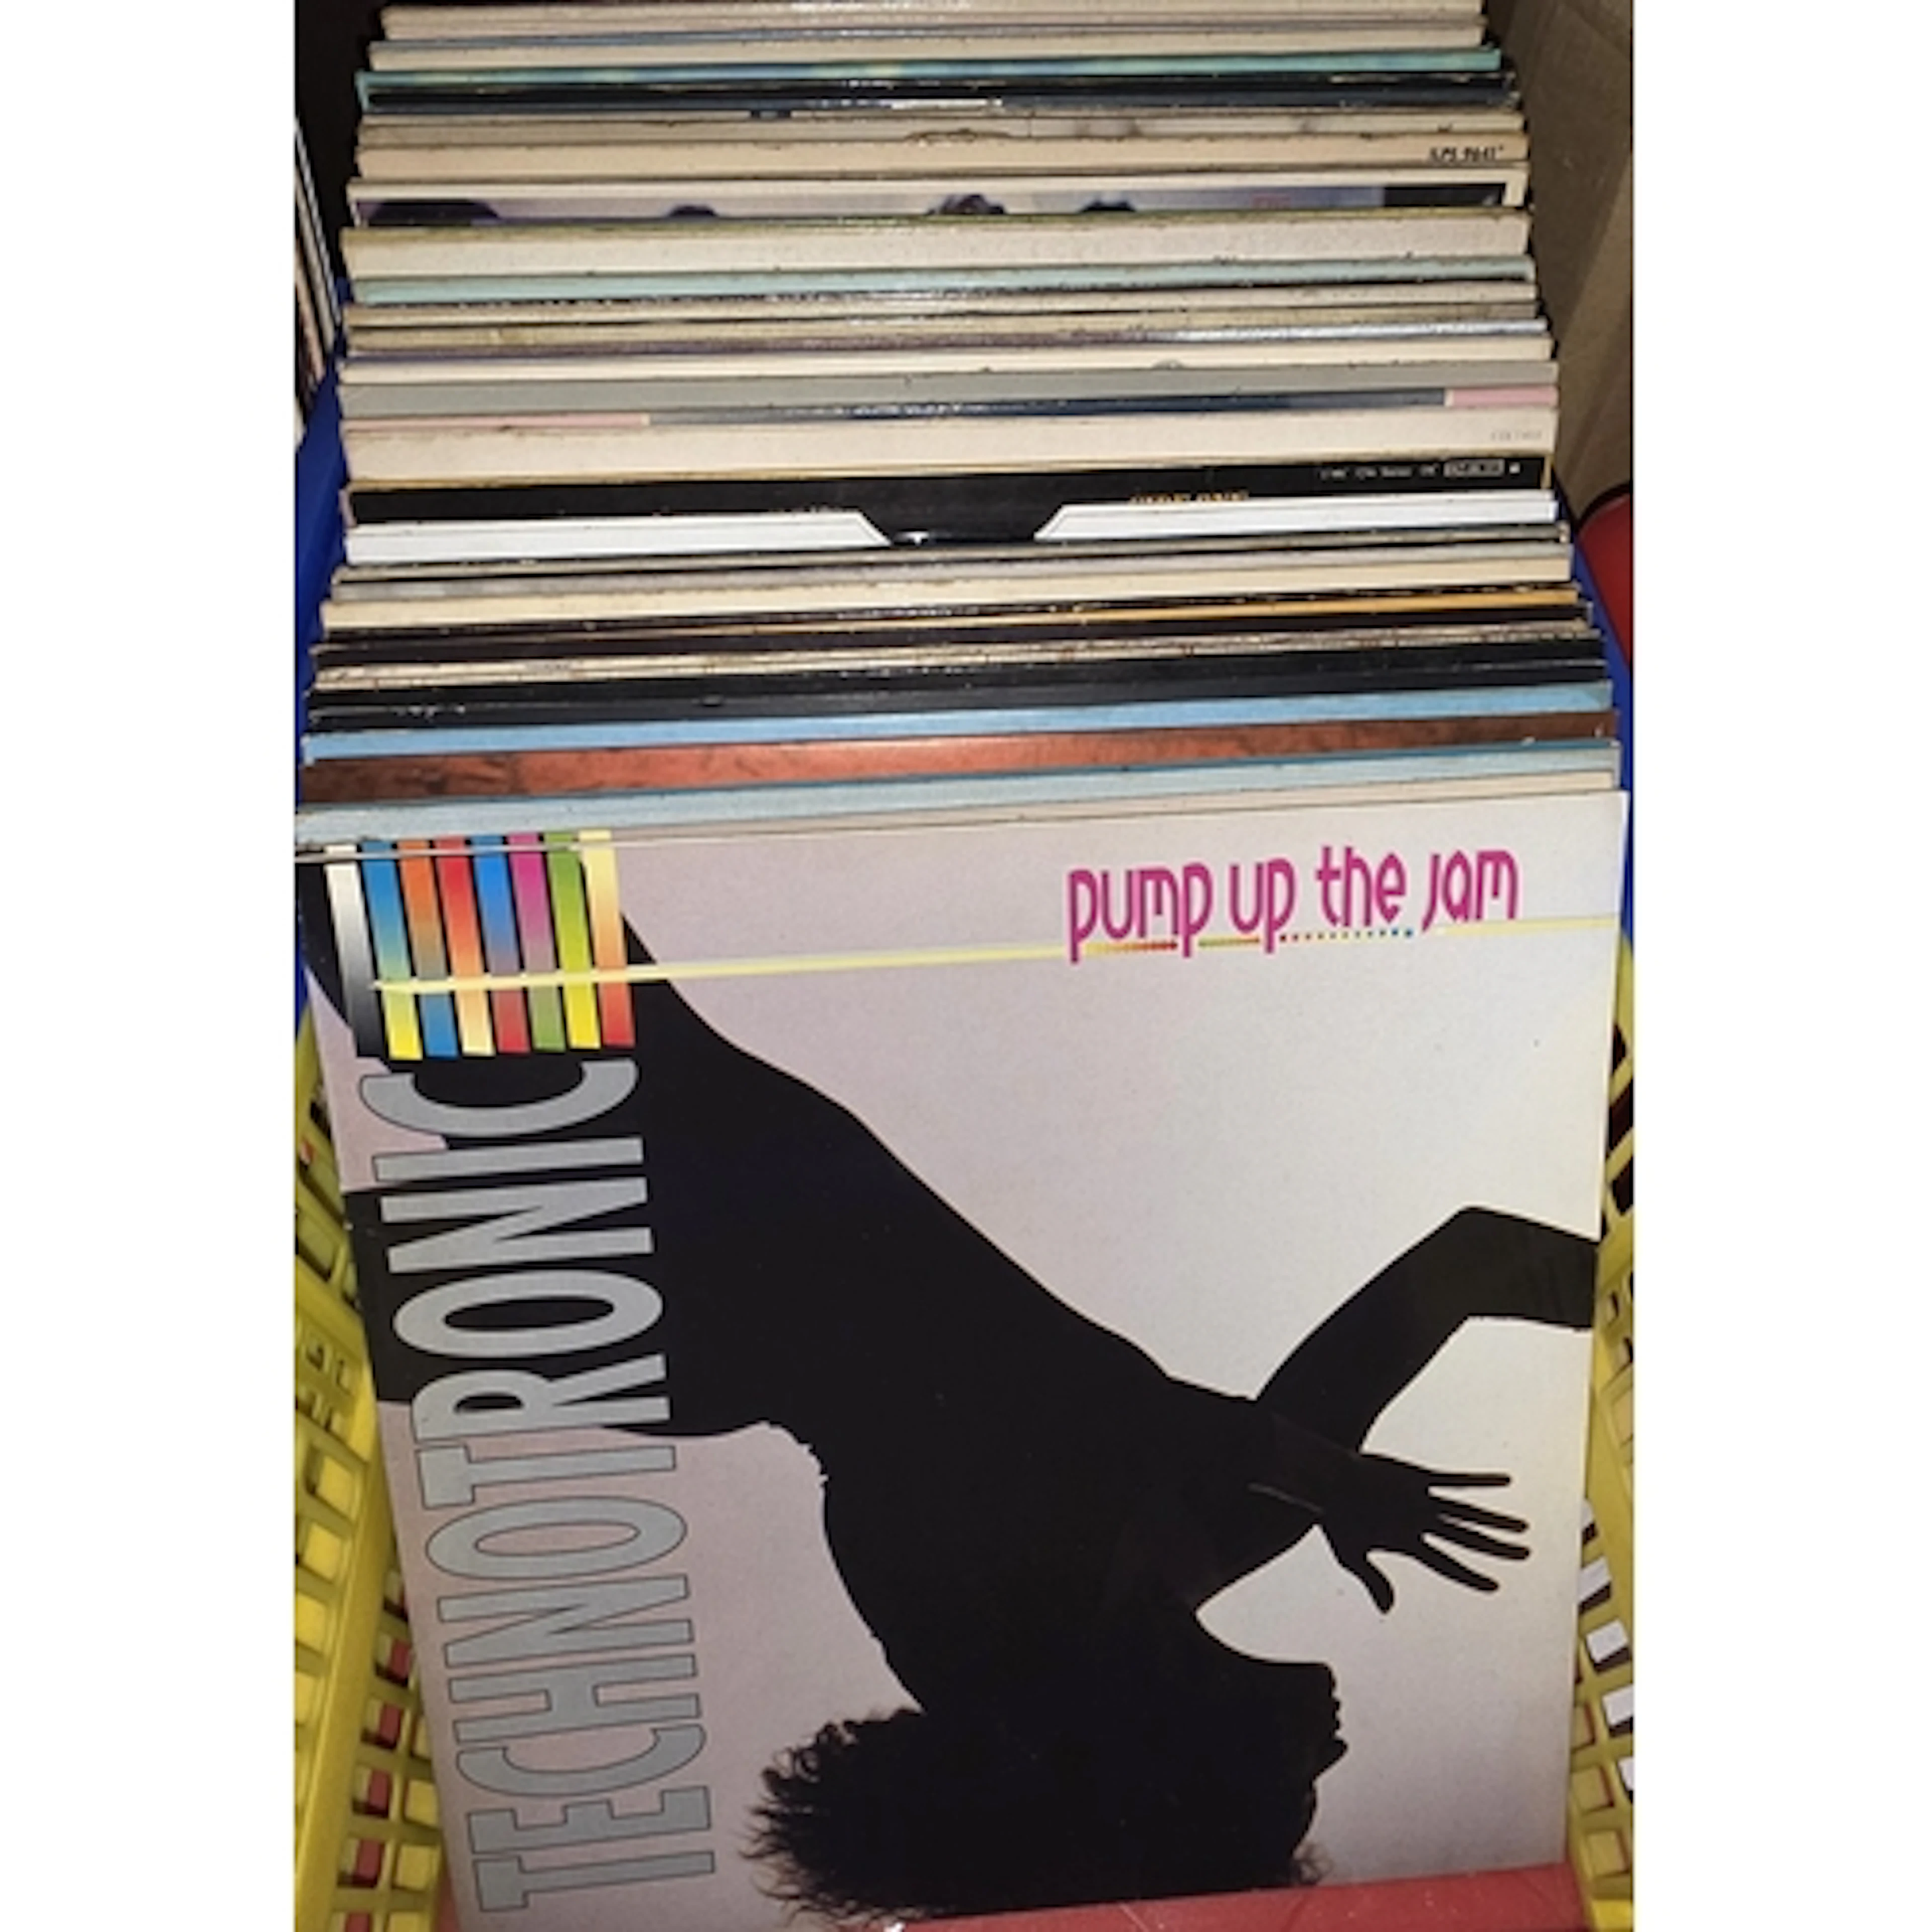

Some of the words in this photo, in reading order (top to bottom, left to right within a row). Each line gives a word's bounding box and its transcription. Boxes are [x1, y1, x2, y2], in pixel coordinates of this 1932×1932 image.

[1067, 862, 1215, 962] pump
[1228, 857, 1298, 953] up
[1316, 846, 1407, 927] the
[1422, 849, 1518, 932] jam
[359, 1058, 715, 1910] TECHNOTRONIC
